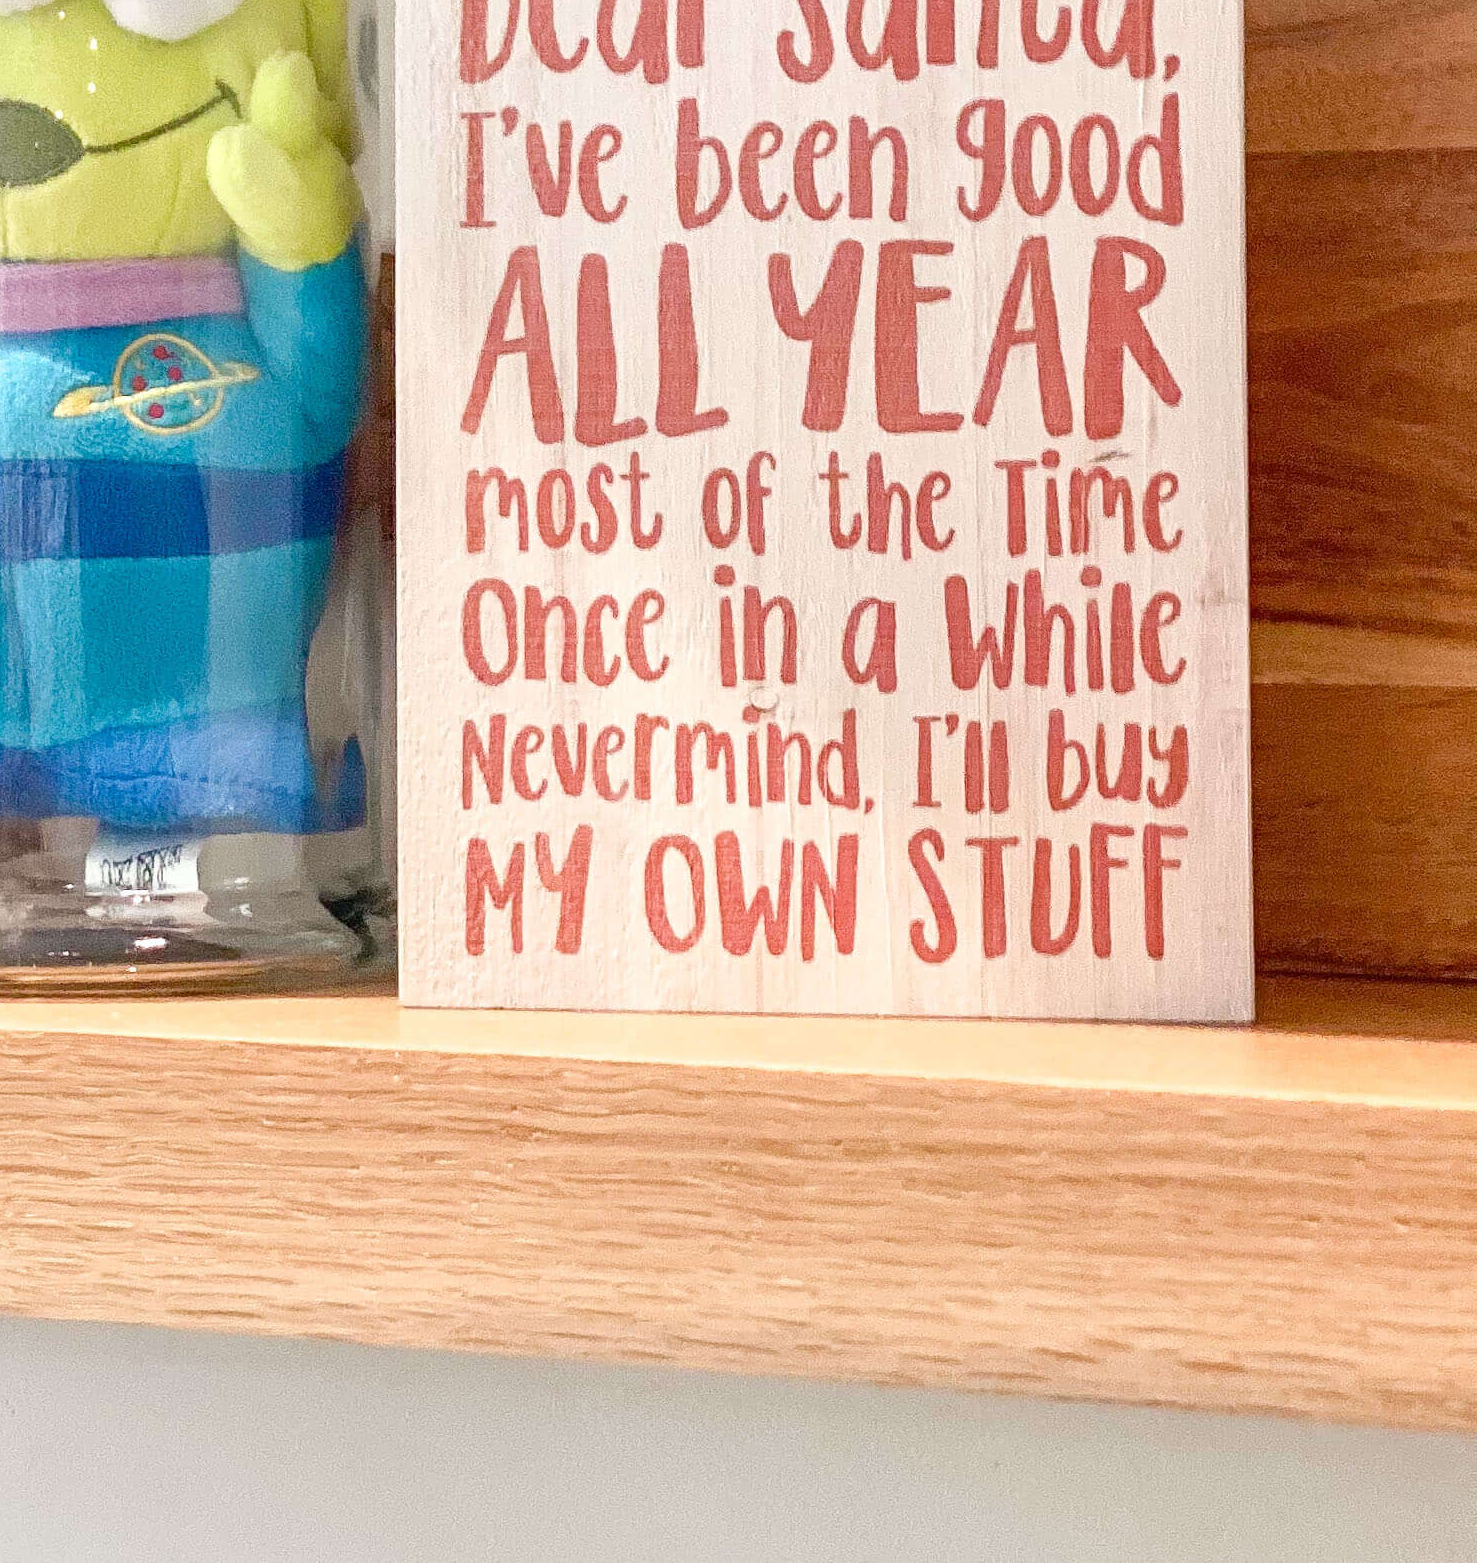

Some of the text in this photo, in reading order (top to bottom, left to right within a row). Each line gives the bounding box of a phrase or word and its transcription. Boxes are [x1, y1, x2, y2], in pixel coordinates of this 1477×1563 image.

[459, 92, 1185, 230] I've been good
[460, 235, 1183, 447] ALL YEAR
[464, 449, 1184, 561] most of the Time
[461, 577, 671, 688] Once
[714, 565, 798, 688] in
[842, 596, 898, 694] a
[460, 708, 1190, 814] Nevermind, I'll buy
[464, 822, 1189, 965] MY OWN STUFF
